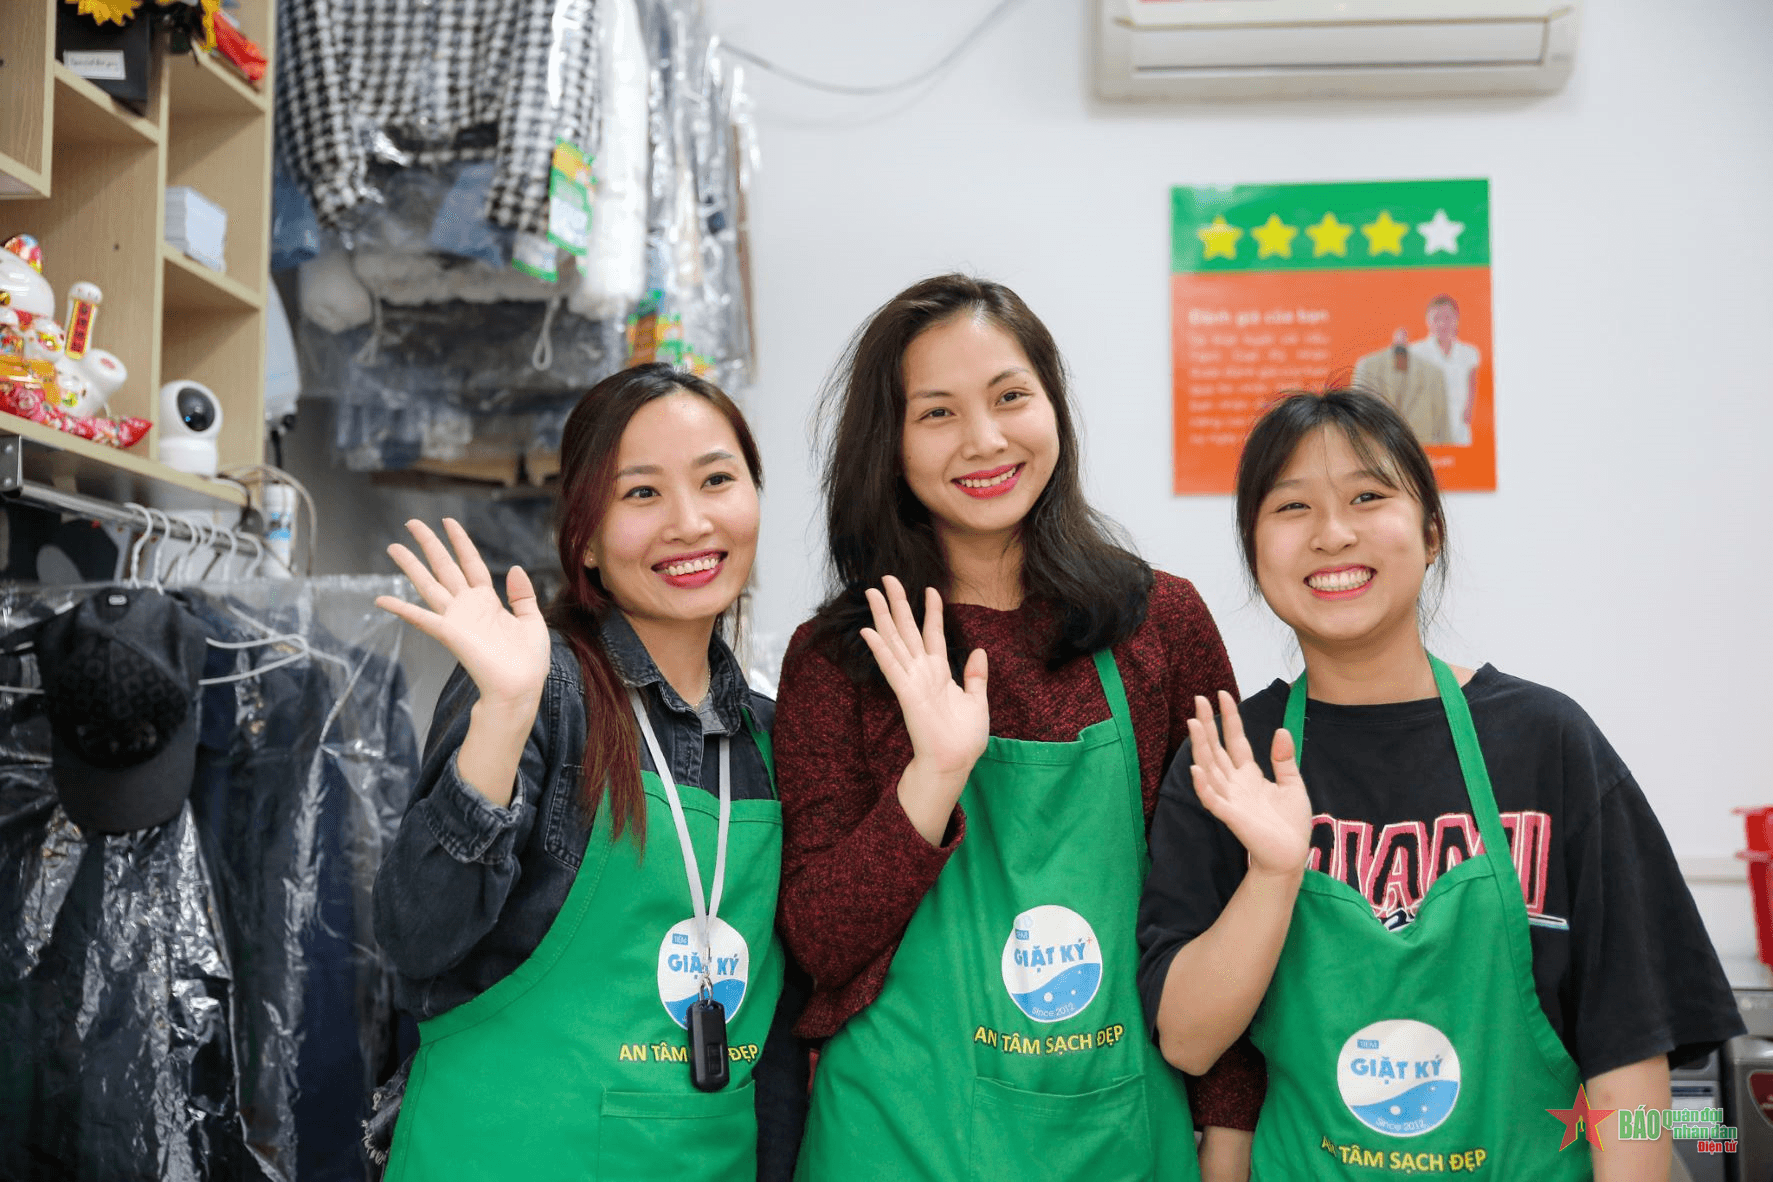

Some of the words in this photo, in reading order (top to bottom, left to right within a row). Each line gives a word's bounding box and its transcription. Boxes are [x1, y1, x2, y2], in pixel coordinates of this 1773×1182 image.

[717, 953, 739, 975] KÝ
[1014, 946, 1054, 973] GIẶT
[1060, 938, 1085, 964] KÝ
[1031, 1006, 1054, 1018] Since
[1055, 1001, 1075, 1017] 2012
[620, 1045, 646, 1061] AN
[651, 1042, 688, 1062] TÂM
[728, 1044, 758, 1063] ĐẸP
[974, 1026, 997, 1047] AN
[1002, 1033, 1040, 1054] TÂM
[1045, 1033, 1092, 1055] SẠCH
[1097, 1025, 1123, 1046] ĐẸP
[1350, 1056, 1408, 1085] GIẶT
[1415, 1055, 1442, 1079] KÝ
[1339, 1145, 1384, 1167] TÂM
[1389, 1152, 1444, 1173] SẠCH
[1449, 1149, 1487, 1172] ĐẸP
